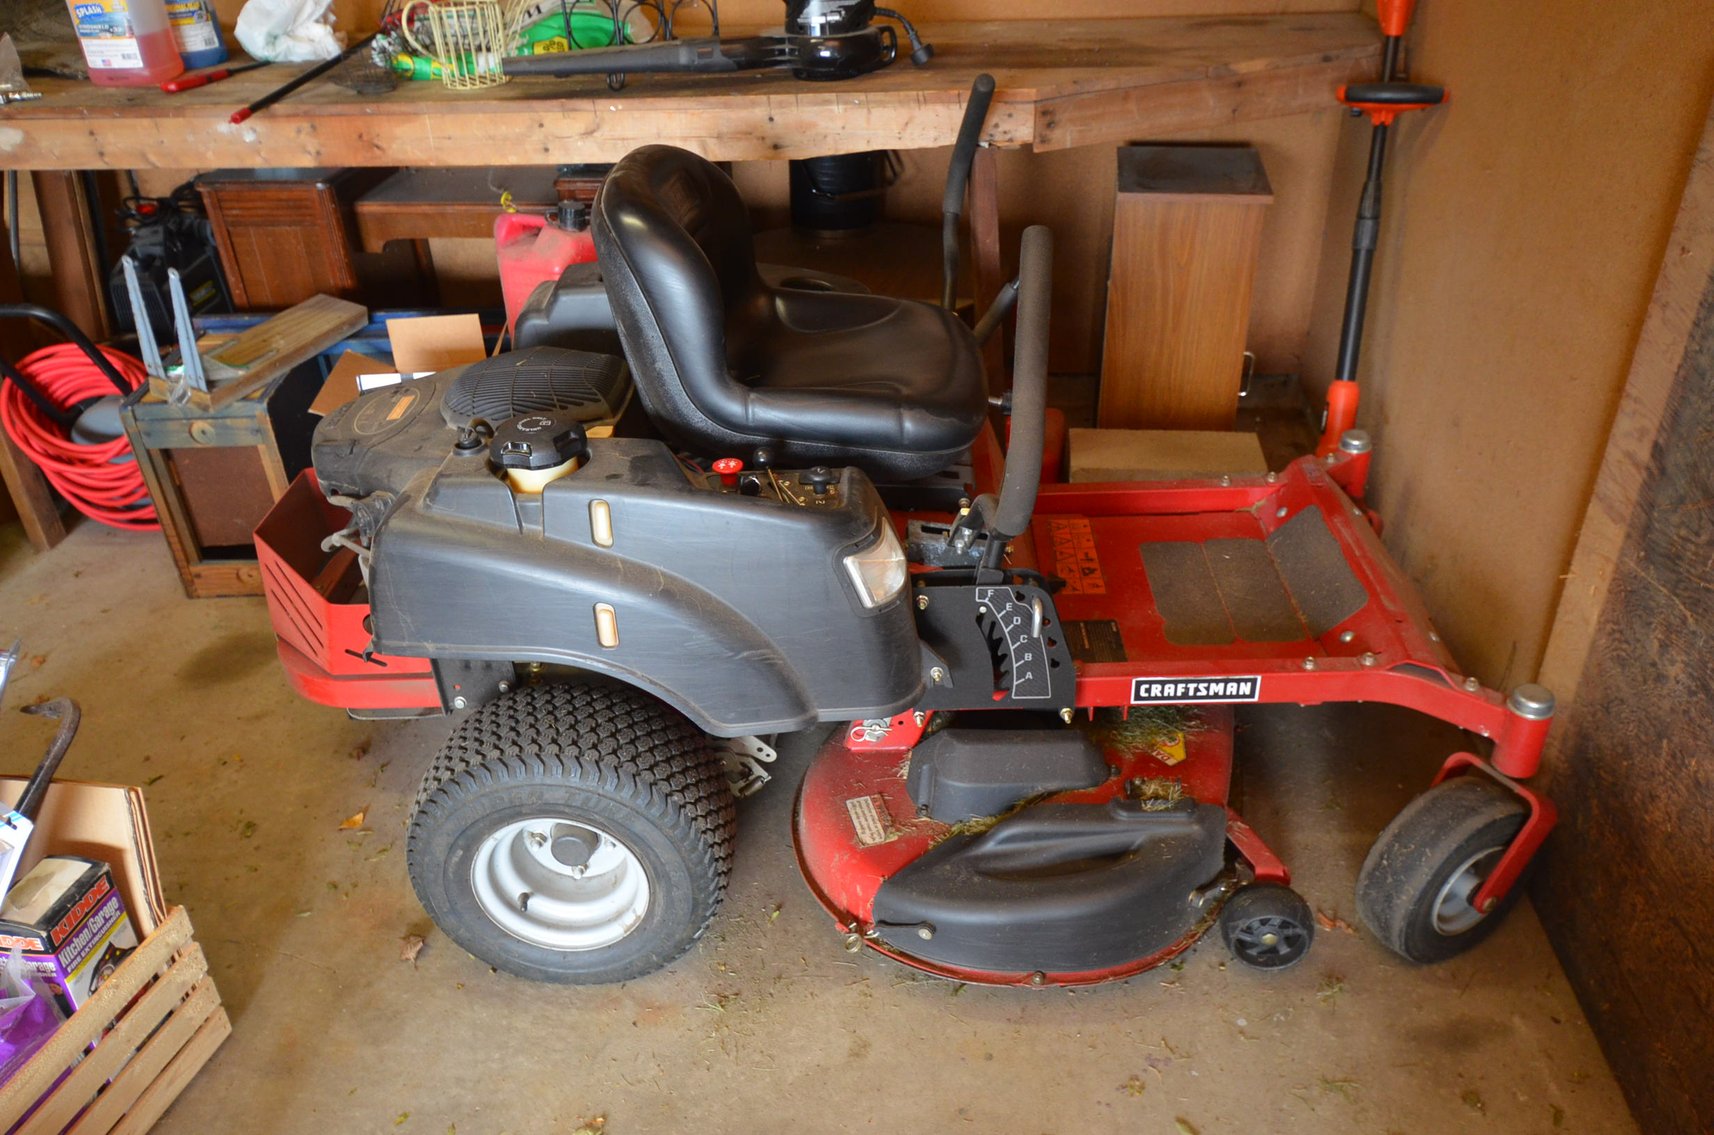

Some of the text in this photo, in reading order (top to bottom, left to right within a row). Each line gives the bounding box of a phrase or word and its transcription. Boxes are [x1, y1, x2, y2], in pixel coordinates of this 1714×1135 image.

[76, 5, 102, 18] SPLASH
[987, 589, 994, 597] F
[1013, 616, 1021, 624] D
[1020, 635, 1028, 643] C
[1025, 653, 1032, 661] B
[1139, 682, 1252, 697] CRAFTSMAN
[50, 875, 110, 946] KIDDE
[57, 896, 119, 968] Kitchen/Garage
[66, 910, 121, 973] FIRE EXTINGUISHER
